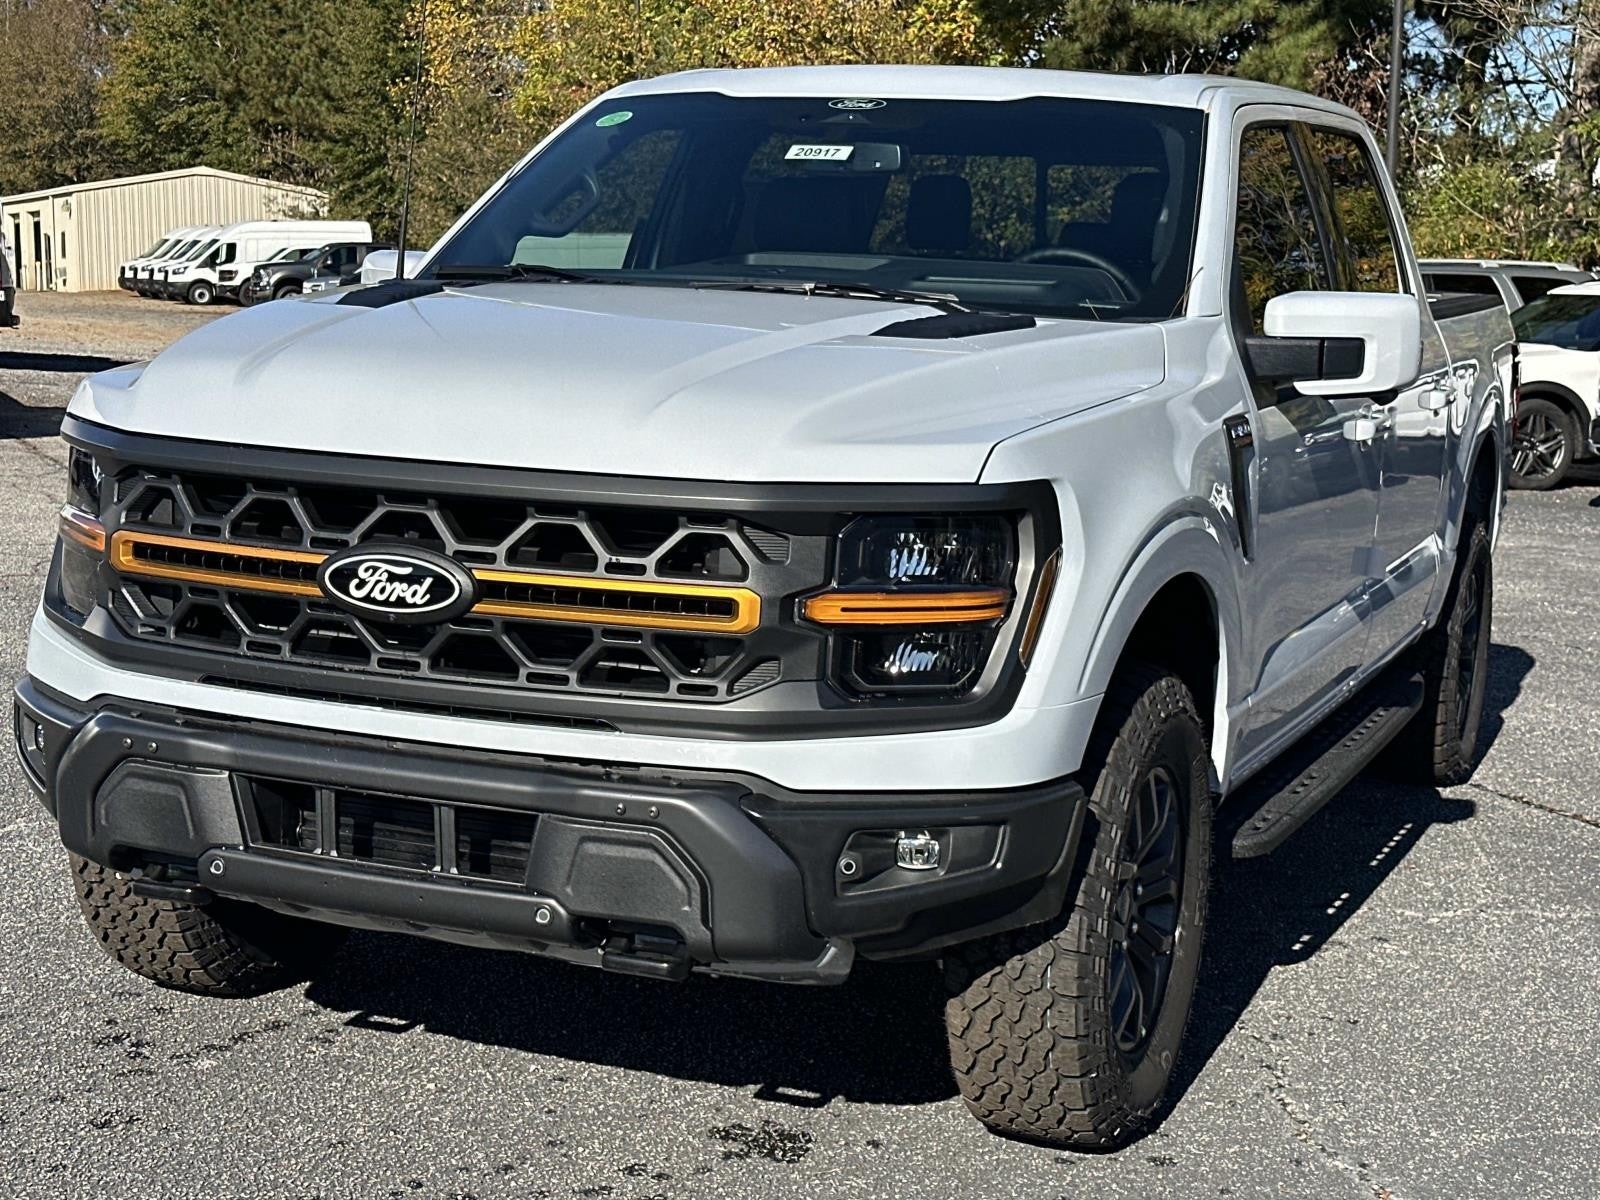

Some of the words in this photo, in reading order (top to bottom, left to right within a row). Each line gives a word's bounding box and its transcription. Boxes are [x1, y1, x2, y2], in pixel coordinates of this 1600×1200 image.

[837, 99, 877, 108] Ford
[794, 147, 842, 157] 20917
[349, 561, 434, 605] Ford
